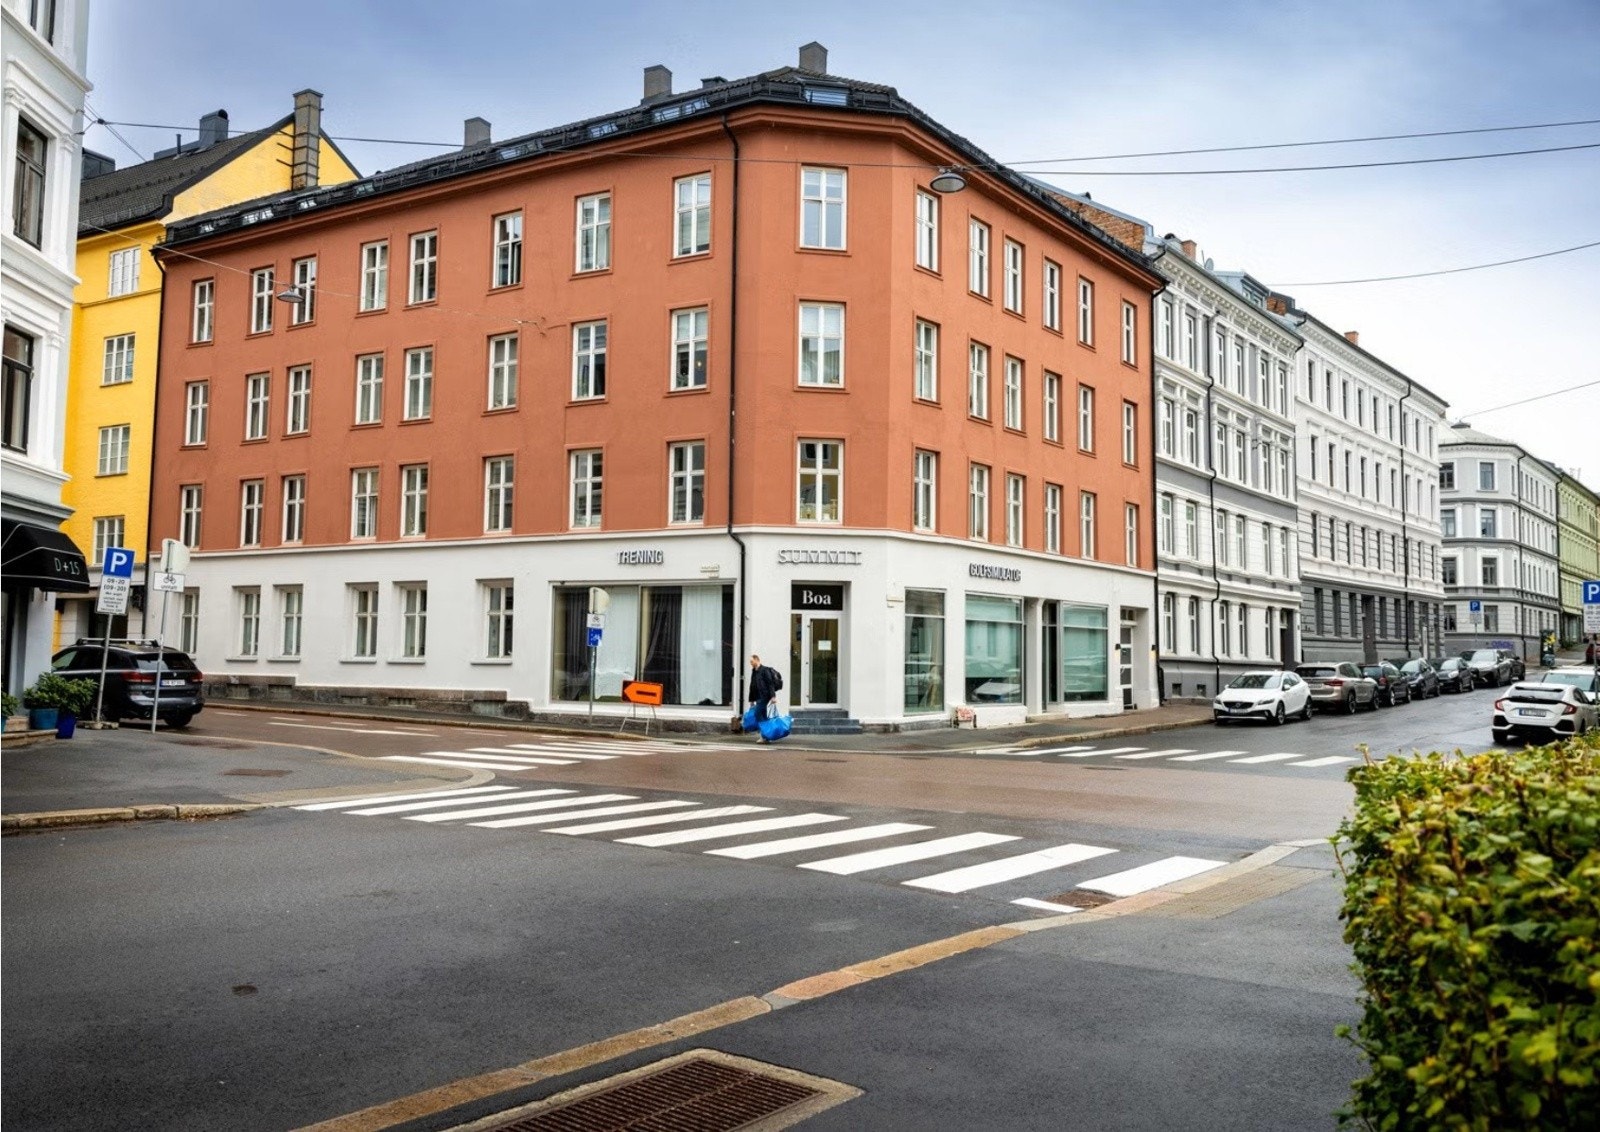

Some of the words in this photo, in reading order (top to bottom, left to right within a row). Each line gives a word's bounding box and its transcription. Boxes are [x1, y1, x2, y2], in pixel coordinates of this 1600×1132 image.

[110, 552, 127, 573] P
[617, 550, 664, 564] TRENING
[778, 549, 862, 565] SUMMIT
[802, 590, 832, 605] Boa
[1588, 584, 1600, 601] P
[1472, 601, 1479, 610] P
